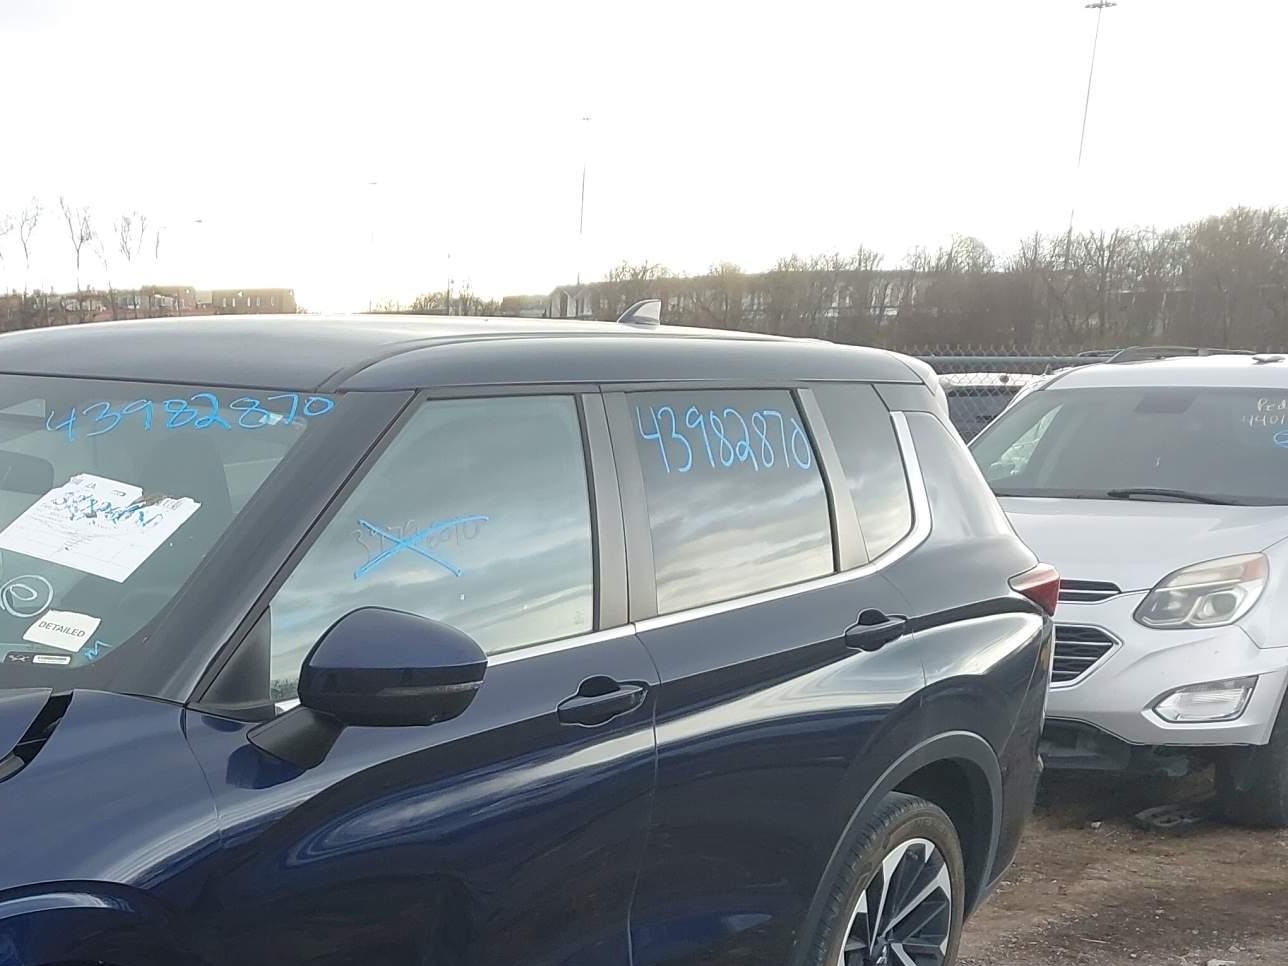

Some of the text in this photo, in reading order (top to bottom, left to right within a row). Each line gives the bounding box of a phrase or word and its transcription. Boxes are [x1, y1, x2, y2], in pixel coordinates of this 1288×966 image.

[46, 393, 335, 441] 43982870
[636, 406, 812, 473] 43982870
[38, 620, 87, 638] DETAILED
